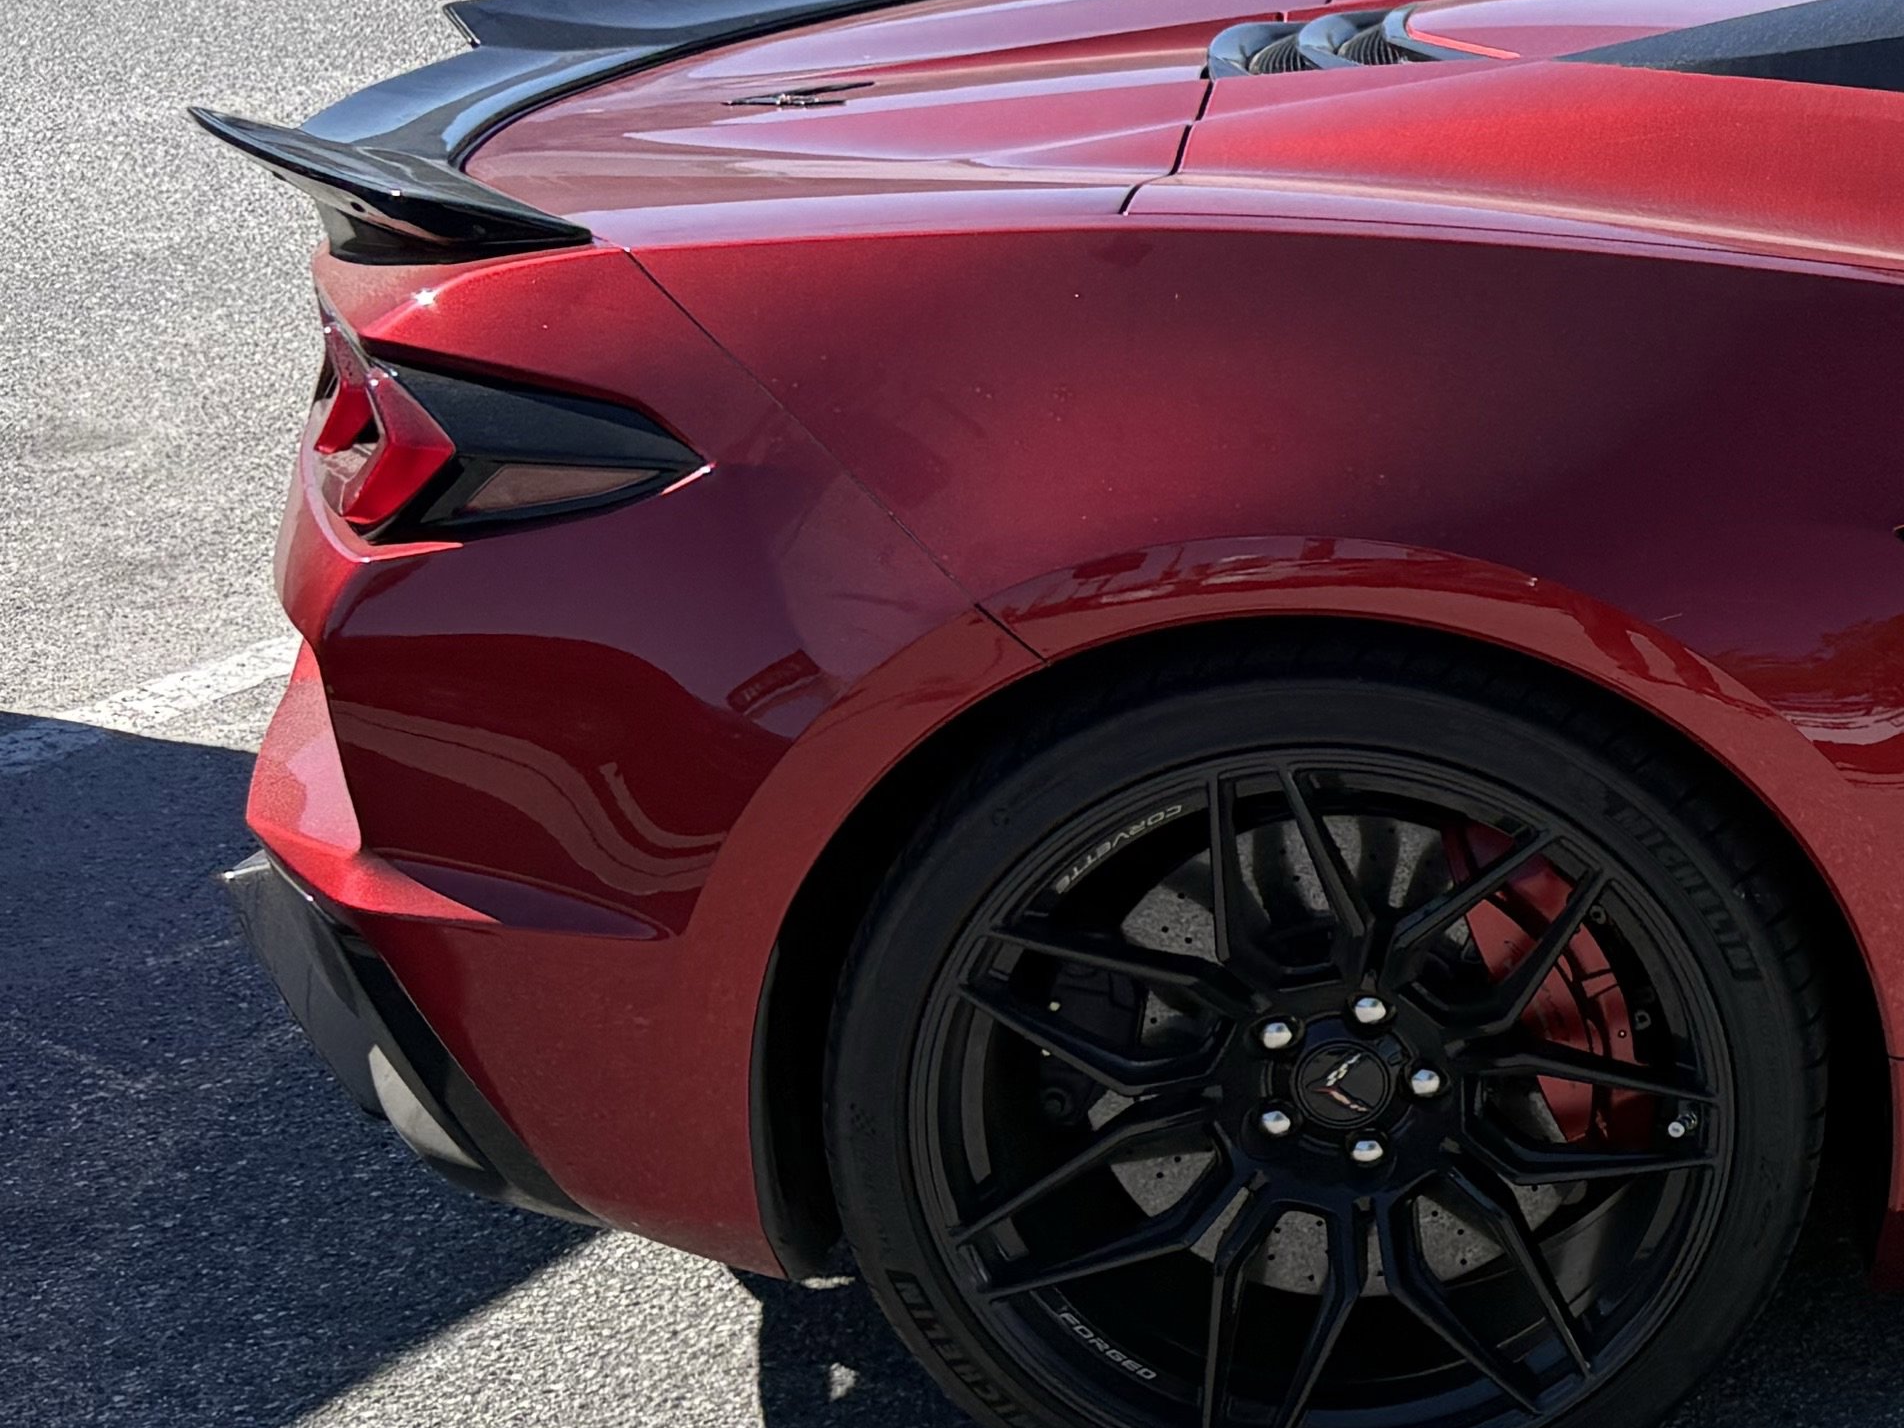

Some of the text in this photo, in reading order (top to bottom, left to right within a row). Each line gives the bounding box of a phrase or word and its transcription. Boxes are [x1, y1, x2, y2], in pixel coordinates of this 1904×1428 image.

[1055, 804, 1182, 894] CORVETTE
[1606, 794, 1761, 980] MICHELIN
[1058, 1311, 1158, 1381] FORGED
